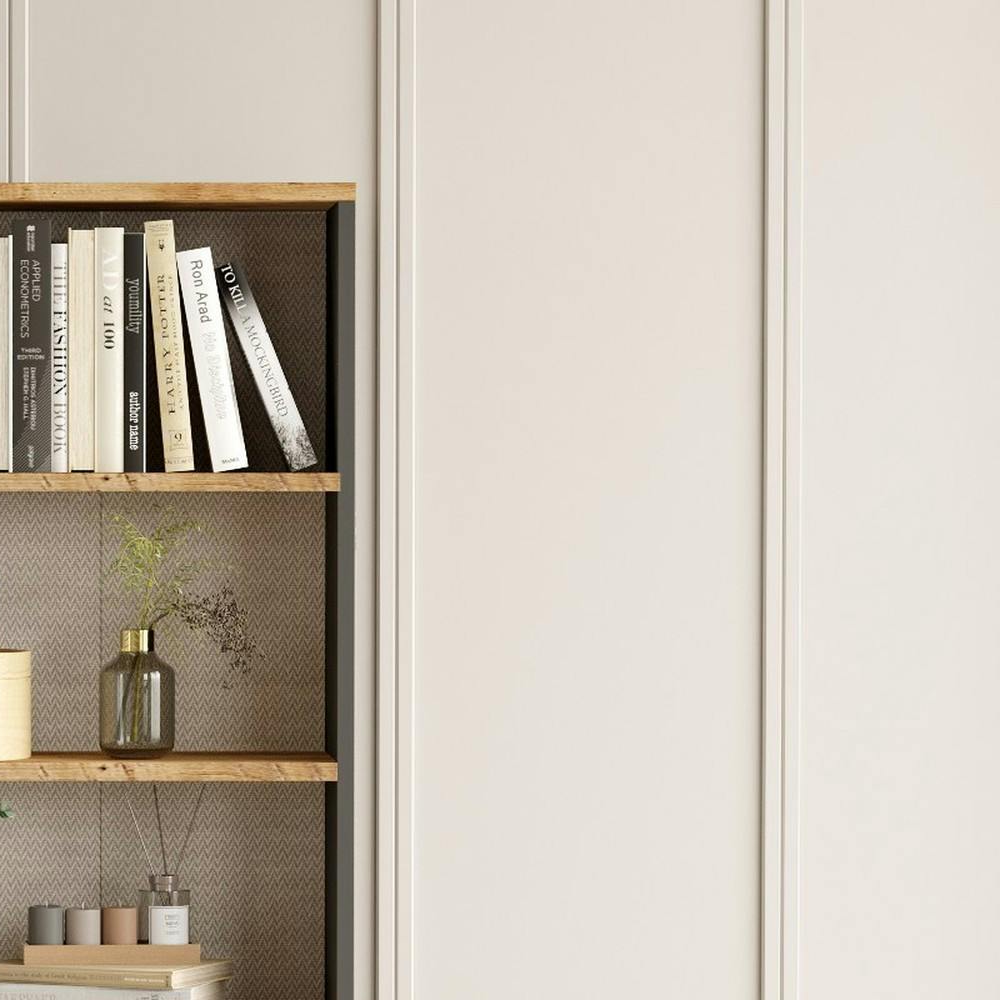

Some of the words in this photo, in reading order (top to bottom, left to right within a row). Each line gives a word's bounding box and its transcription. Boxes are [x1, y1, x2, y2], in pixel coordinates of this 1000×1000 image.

[32, 260, 41, 302] APPLIED
[53, 262, 66, 304] THE
[190, 260, 203, 287] Ron
[20, 260, 30, 339] ECONOMETRICS
[103, 296, 113, 314] at
[126, 278, 142, 334] youmility
[157, 274, 169, 339] POTTER
[196, 292, 212, 323] Arad
[53, 311, 66, 396] FASHION
[103, 322, 115, 349] 100
[221, 262, 236, 283] TO
[229, 284, 248, 312] KILL
[245, 325, 289, 417] MOCKINGBIRD
[163, 348, 176, 415] HARRY
[53, 403, 66, 453] BOOK
[129, 391, 141, 423] author
[129, 424, 139, 451] name
